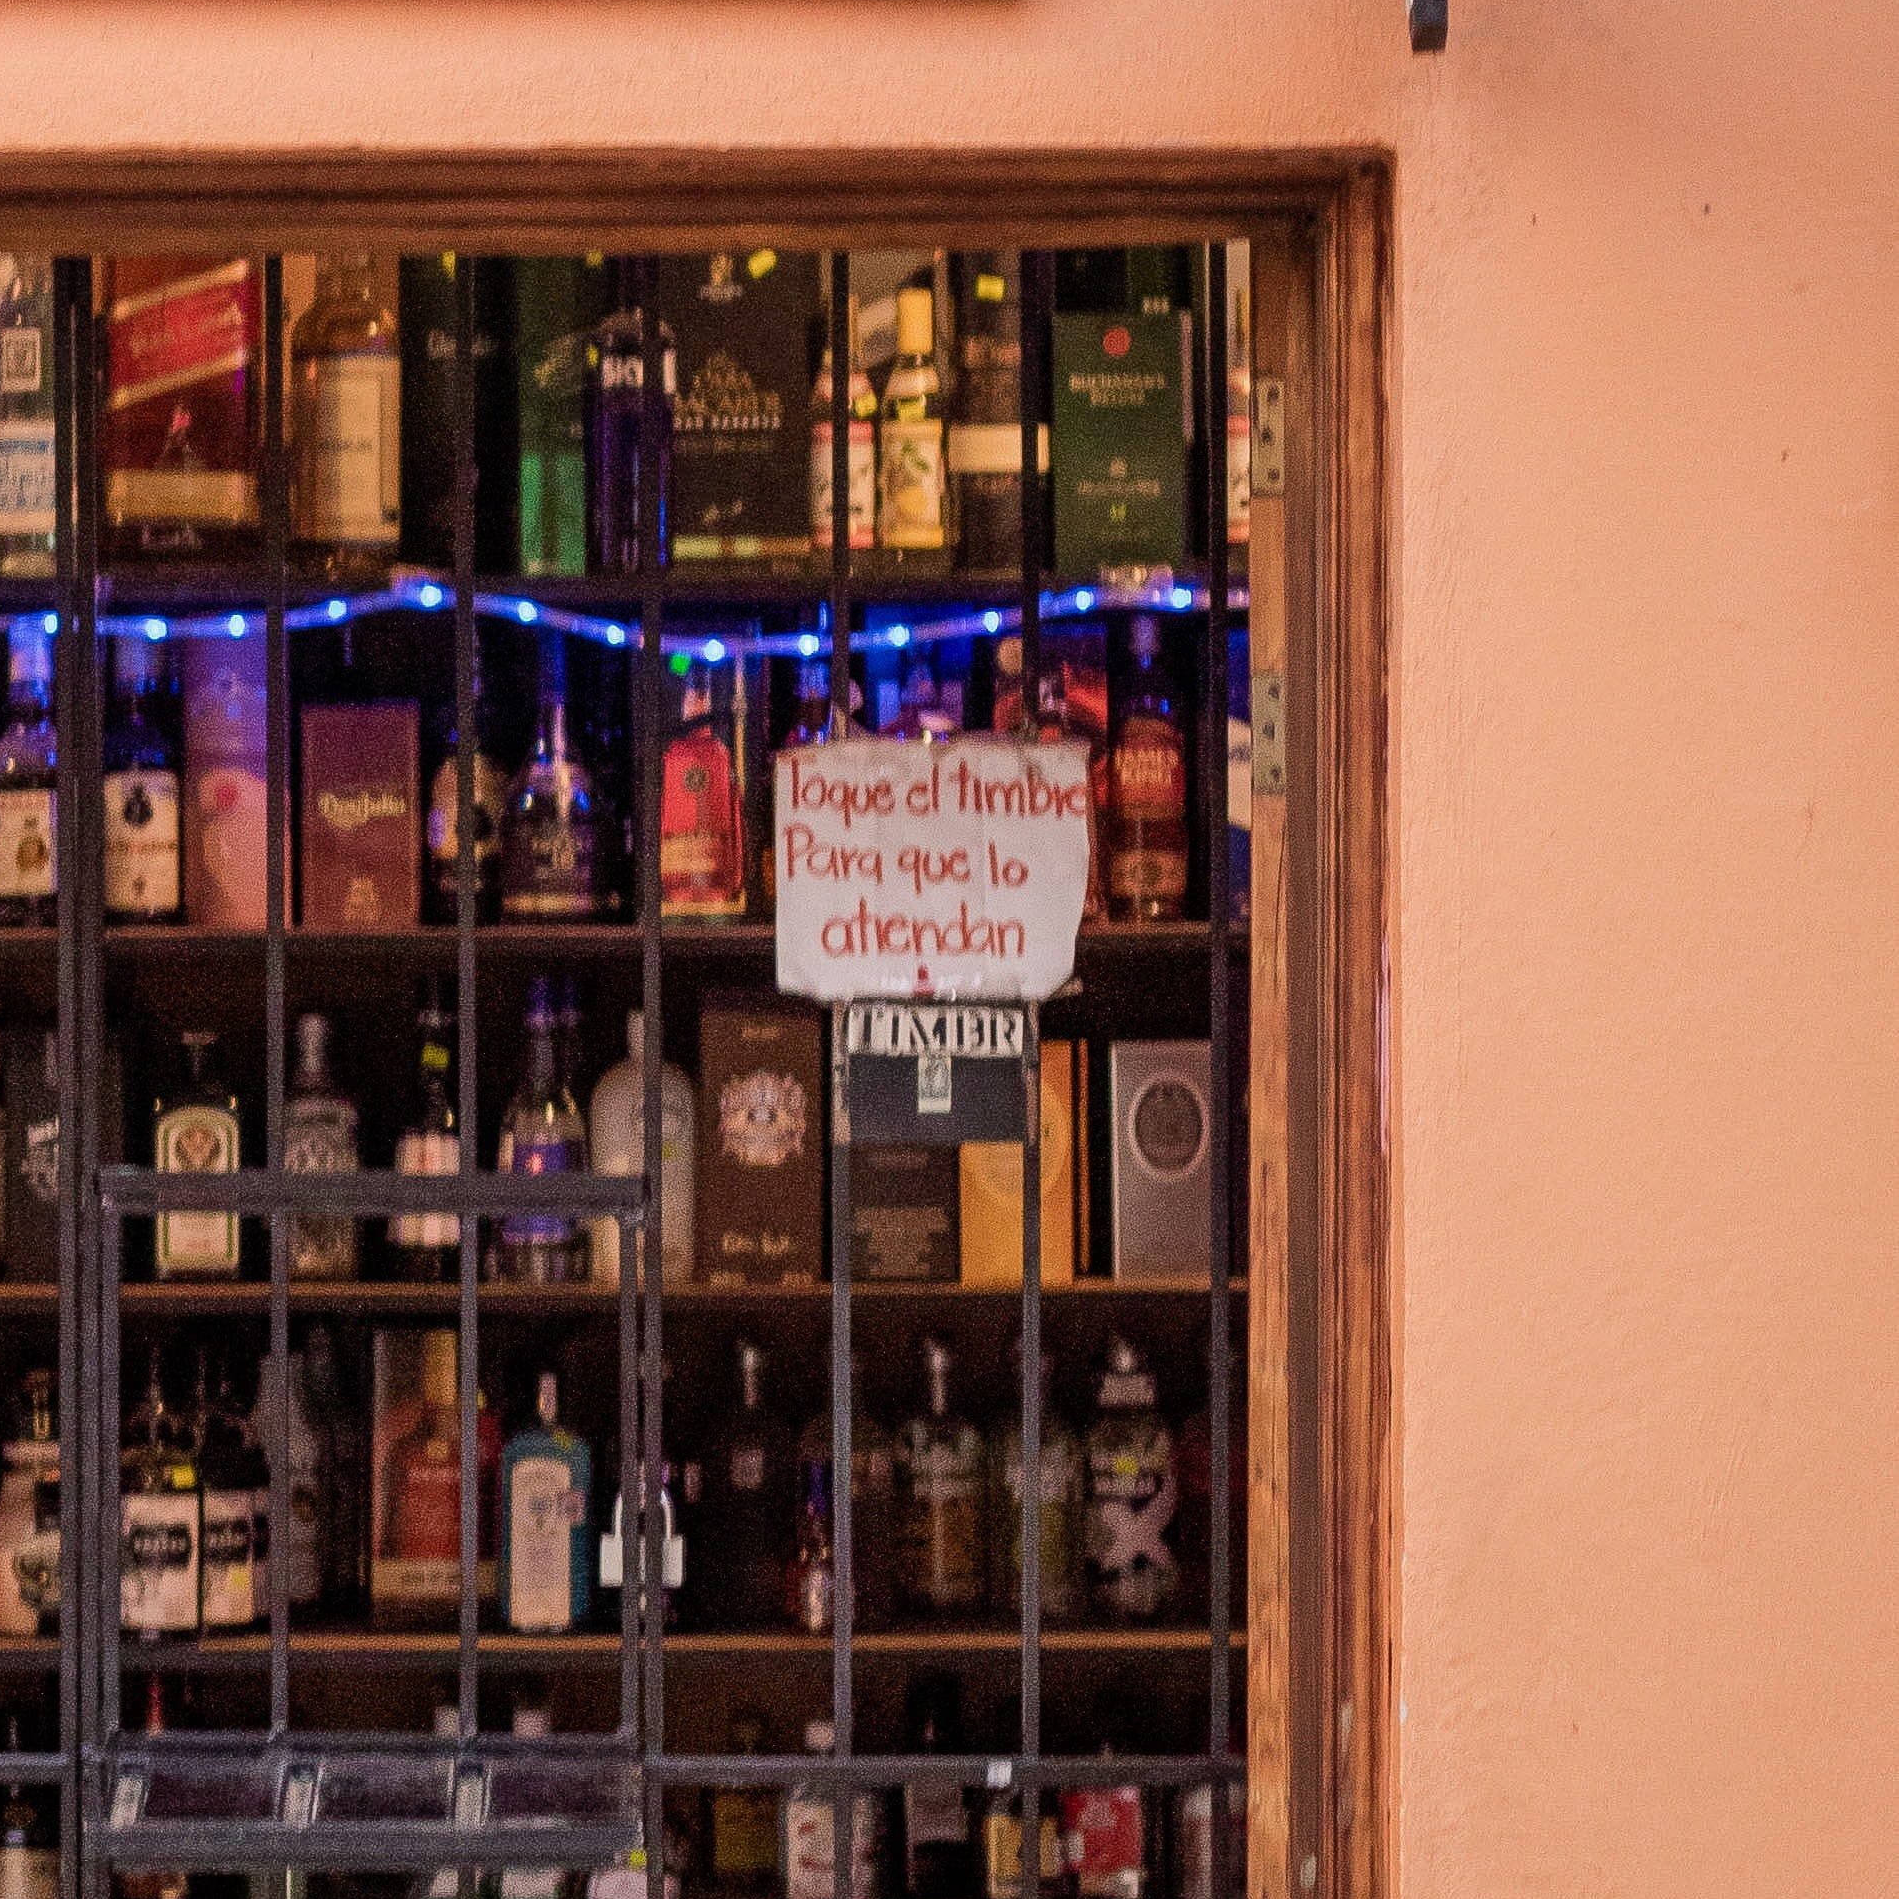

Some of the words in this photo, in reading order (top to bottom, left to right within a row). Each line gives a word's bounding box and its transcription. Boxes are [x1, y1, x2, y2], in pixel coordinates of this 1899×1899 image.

[906, 761, 941, 816] el
[950, 758, 1087, 817] timbre
[783, 822, 882, 886] Para
[897, 845, 970, 897] que
[988, 841, 1029, 887] lo
[821, 897, 1025, 958] atiendan
